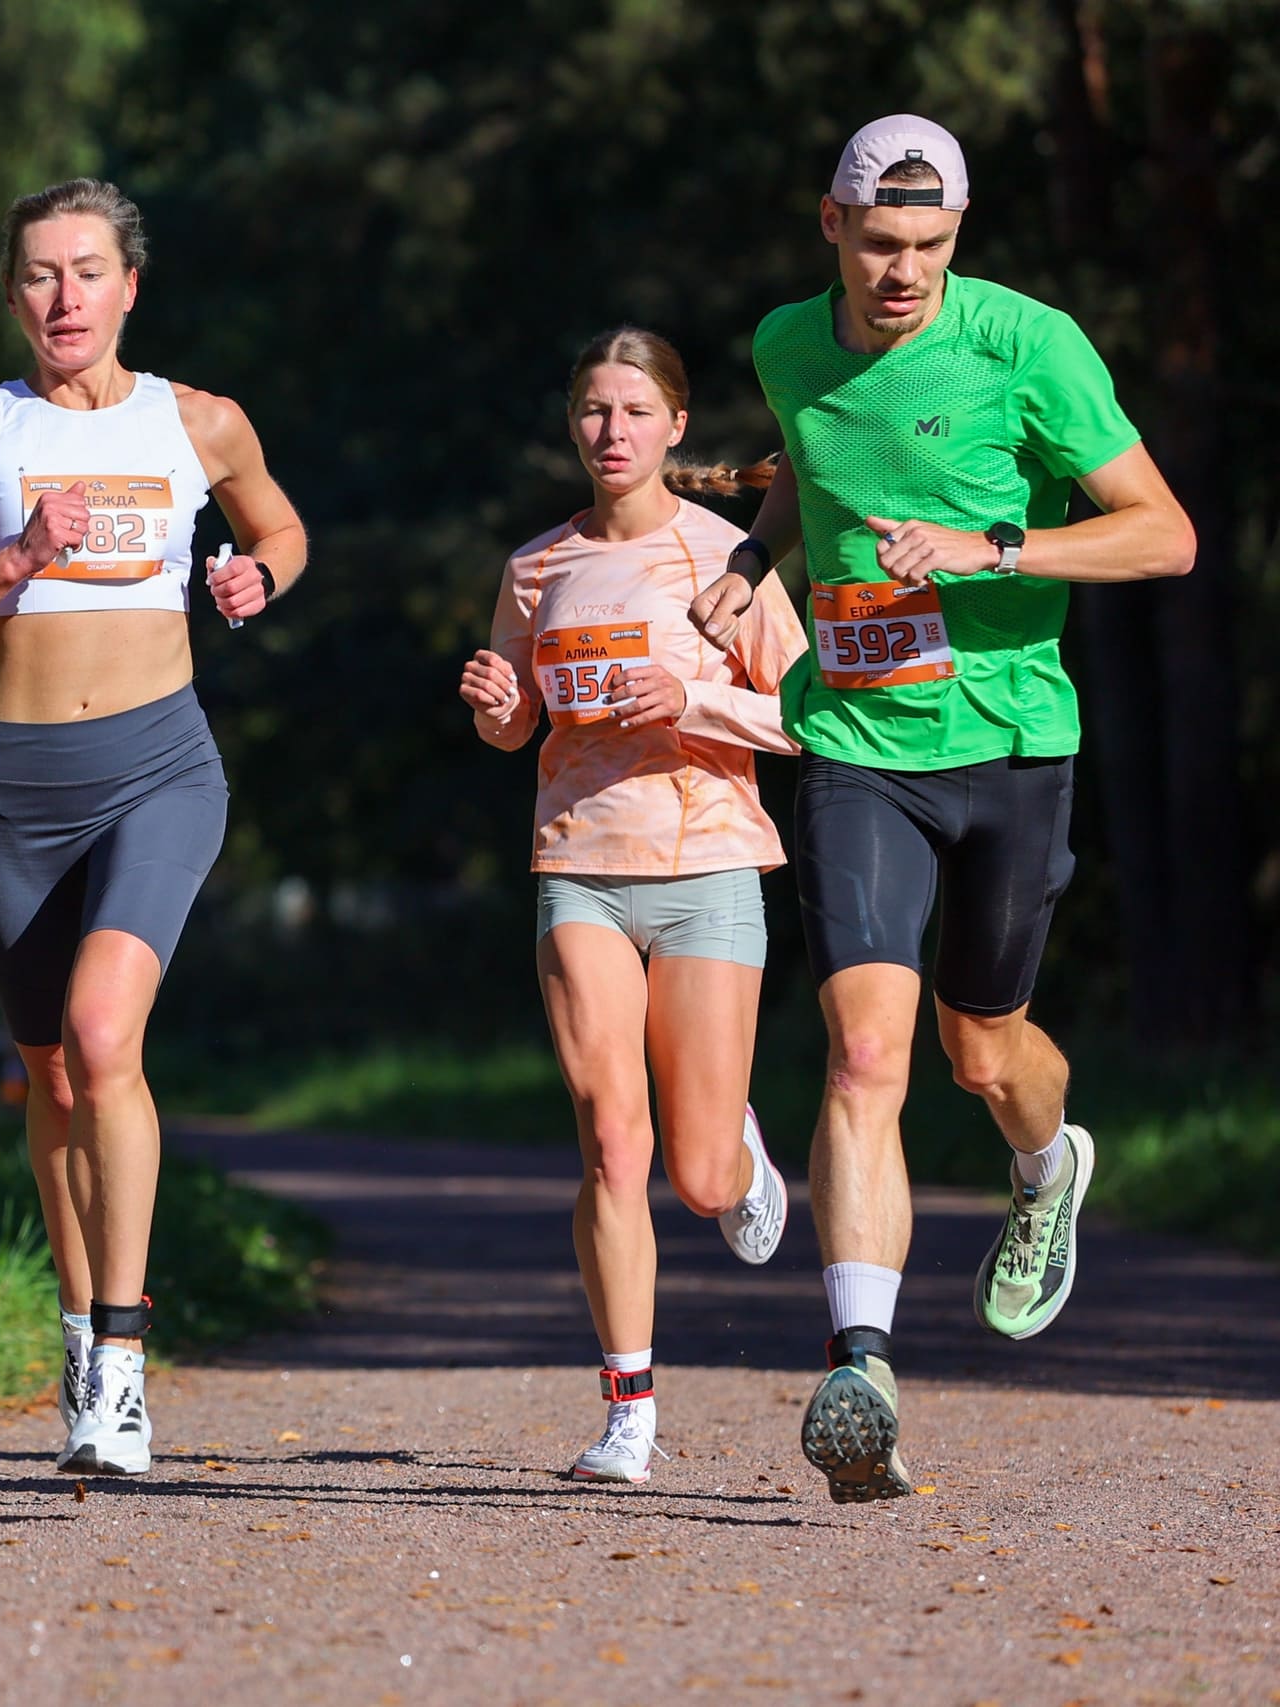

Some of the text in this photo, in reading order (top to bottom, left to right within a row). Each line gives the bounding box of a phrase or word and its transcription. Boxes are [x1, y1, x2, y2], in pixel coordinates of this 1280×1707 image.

[84, 495, 138, 508] ДЕЖДА
[153, 518, 168, 531] 12
[72, 513, 146, 554] 82
[850, 604, 885, 618] ЕГОР
[923, 622, 939, 635] 12
[832, 621, 921, 666] 592
[565, 646, 608, 661] АЛИНА
[1048, 1186, 1073, 1269] HOKA
